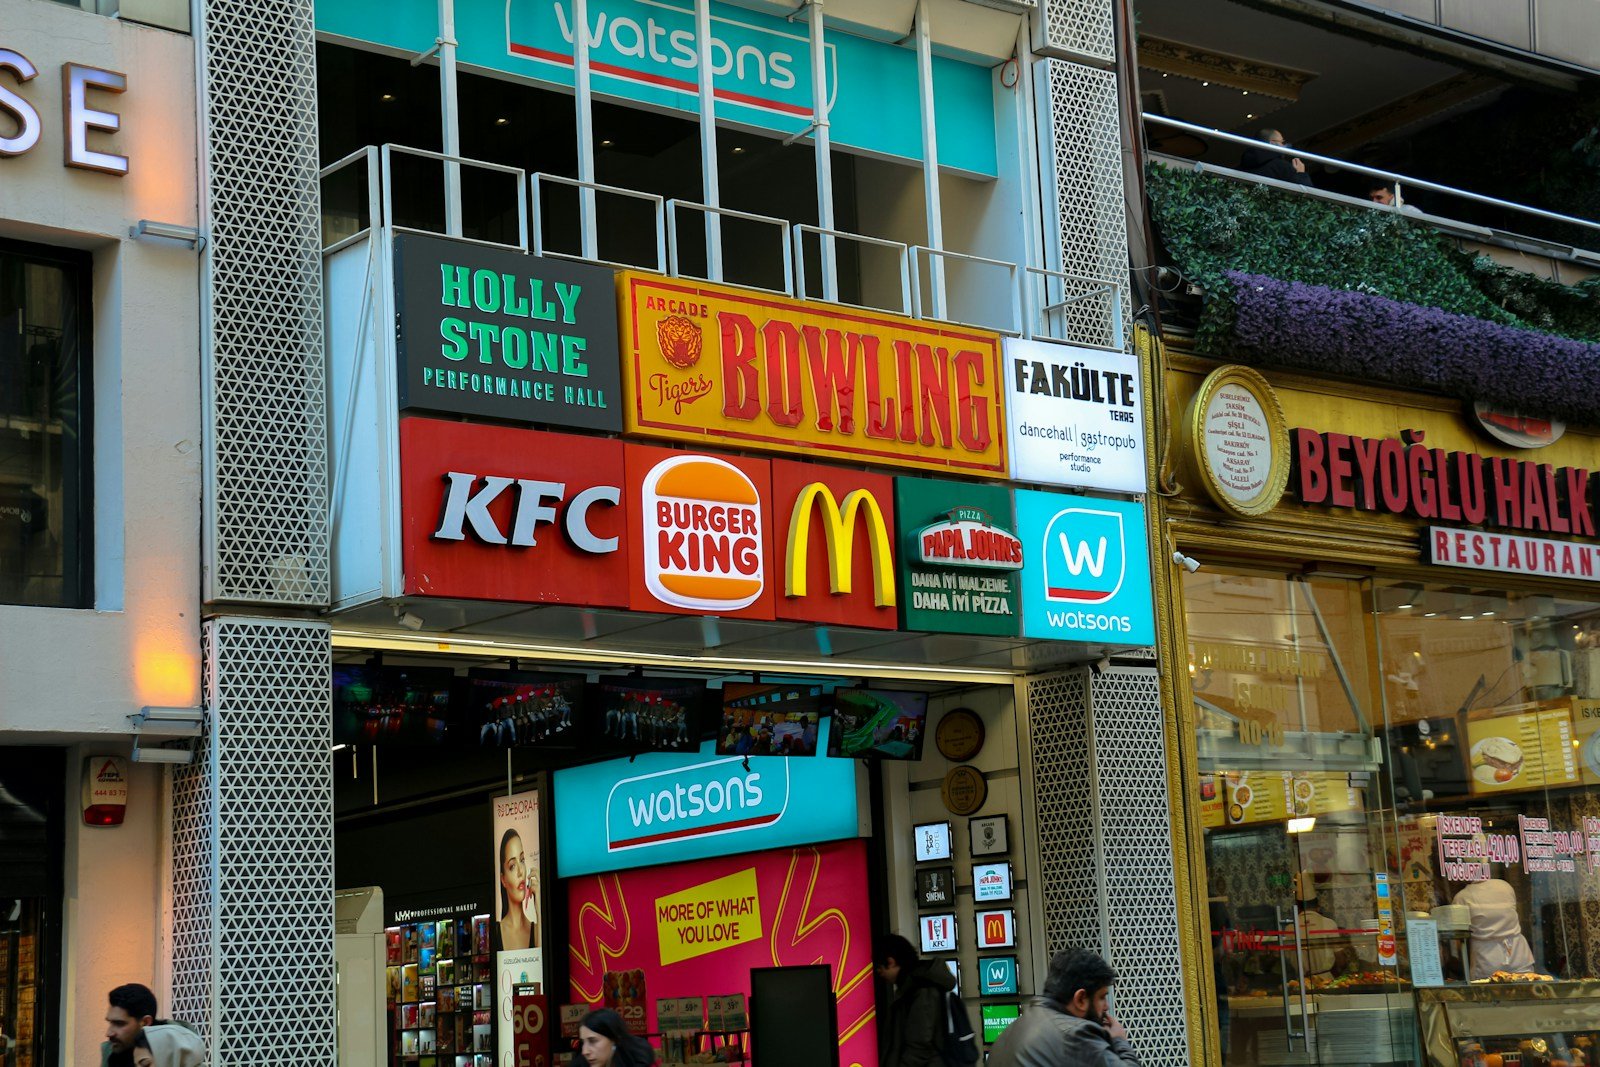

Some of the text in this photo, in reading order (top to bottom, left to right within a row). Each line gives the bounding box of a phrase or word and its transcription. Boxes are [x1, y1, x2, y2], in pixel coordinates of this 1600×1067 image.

[554, 2, 796, 90] watsons
[440, 263, 582, 325] HOLLY
[646, 296, 708, 319] ARCADE
[440, 316, 589, 378] STONE
[423, 366, 607, 409] PERFORMANCE HALL
[649, 372, 713, 415] Tigers
[716, 311, 991, 453] BOWLING
[1014, 358, 1135, 407] FAKÜLTE
[1019, 421, 1136, 451] dancehall gastropub
[1059, 452, 1102, 465] performance
[1070, 462, 1091, 473] studio
[1293, 427, 1596, 537] BEYOĞLU HALK
[431, 471, 621, 554] KFC
[656, 501, 757, 536] BURGER
[959, 510, 981, 521] PIZZA
[657, 530, 759, 576] KING
[923, 529, 966, 559] PAPA
[1435, 530, 1600, 578] RESTAURAN
[911, 572, 941, 588] DAHA
[942, 571, 957, 590] İYİ
[913, 590, 1013, 615] DAHA İYİ PİZZA.
[1046, 609, 1132, 633] watsons
[628, 772, 763, 827] watsons
[394, 903, 478, 922] NYX PROFESSIONAL MAKEUP
[658, 896, 756, 924] MORE OF WHAT
[677, 922, 740, 945] YOU LOVE
[932, 940, 945, 948] KFC
